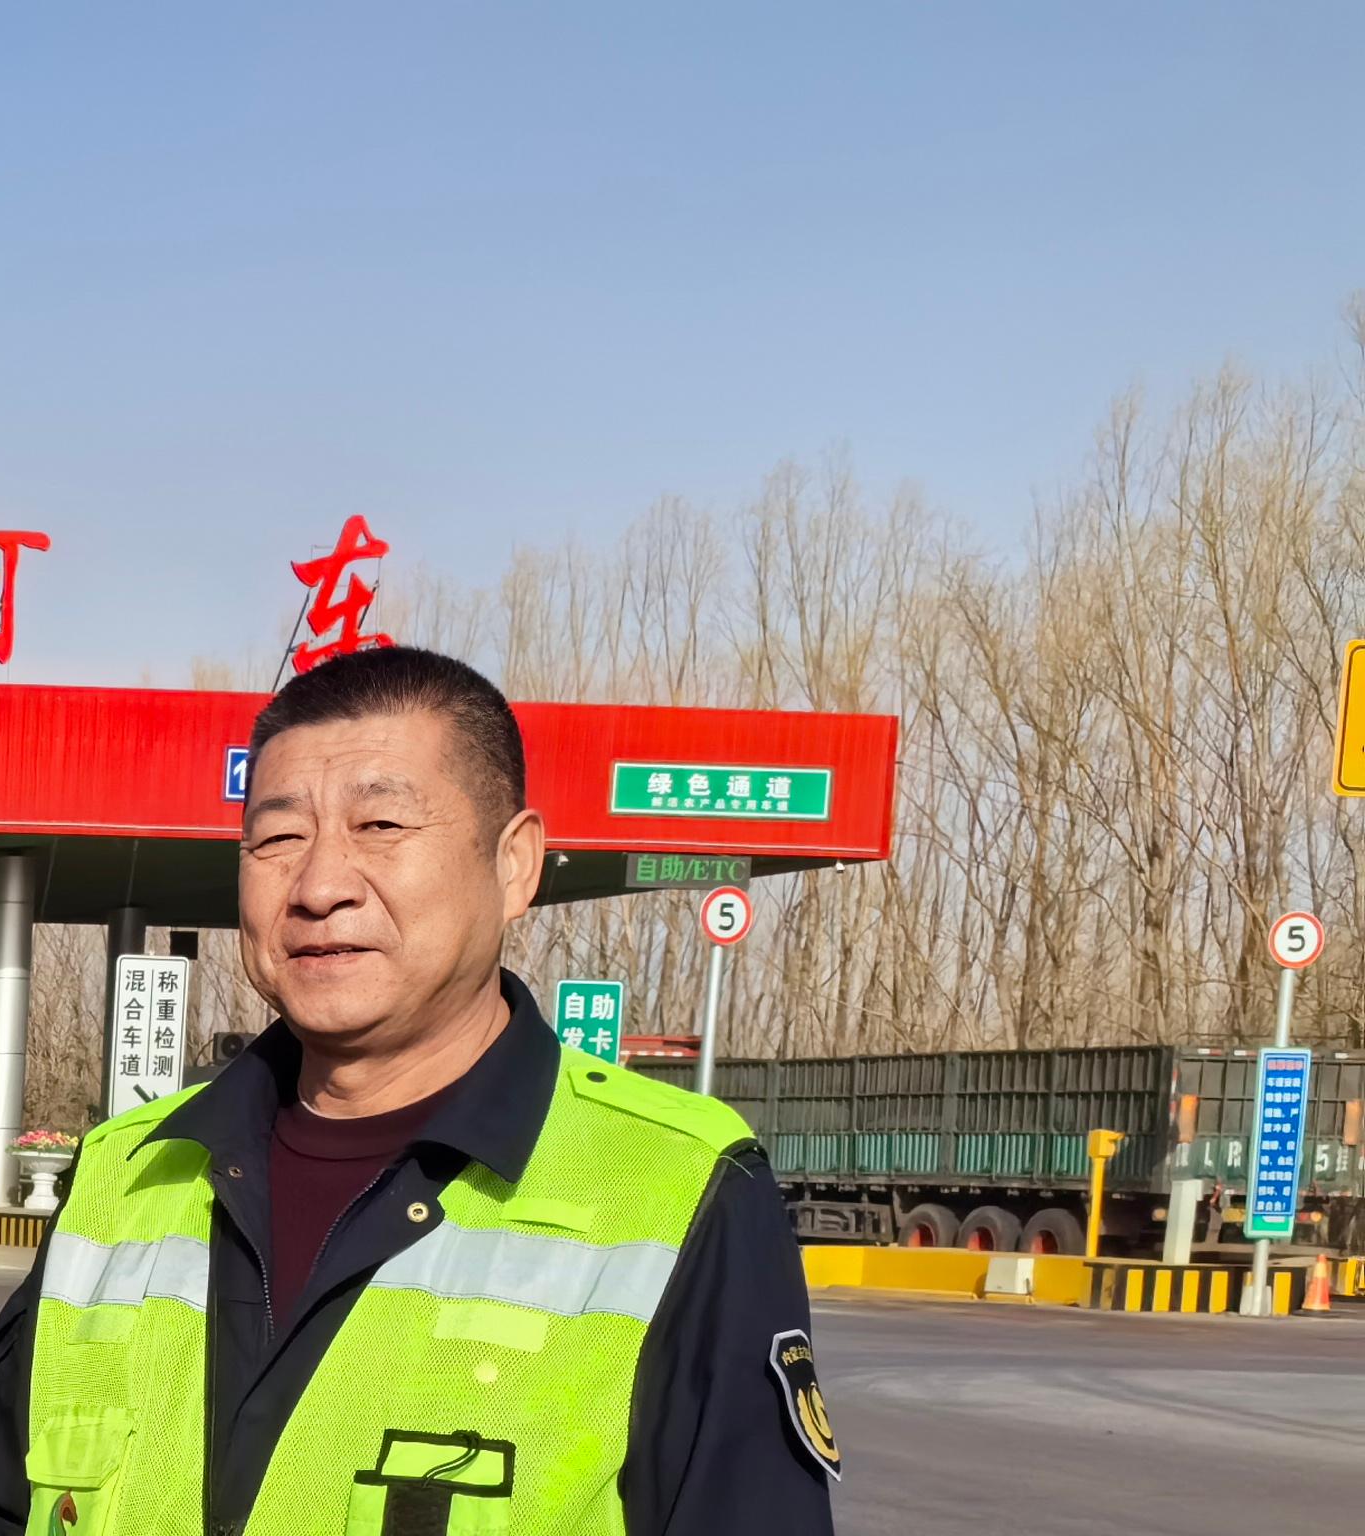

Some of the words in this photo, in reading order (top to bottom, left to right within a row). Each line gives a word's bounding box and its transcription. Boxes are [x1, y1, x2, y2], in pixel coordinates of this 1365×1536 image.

[647, 772, 792, 799] 绿色通道
[636, 855, 747, 882] 自助/ETC
[718, 902, 735, 931] 5
[1287, 925, 1305, 952] 5
[565, 992, 615, 1020] 自助
[120, 969, 146, 1077] 混合车道
[152, 970, 179, 1078] 称重检测
[562, 1026, 614, 1055] 发卡
